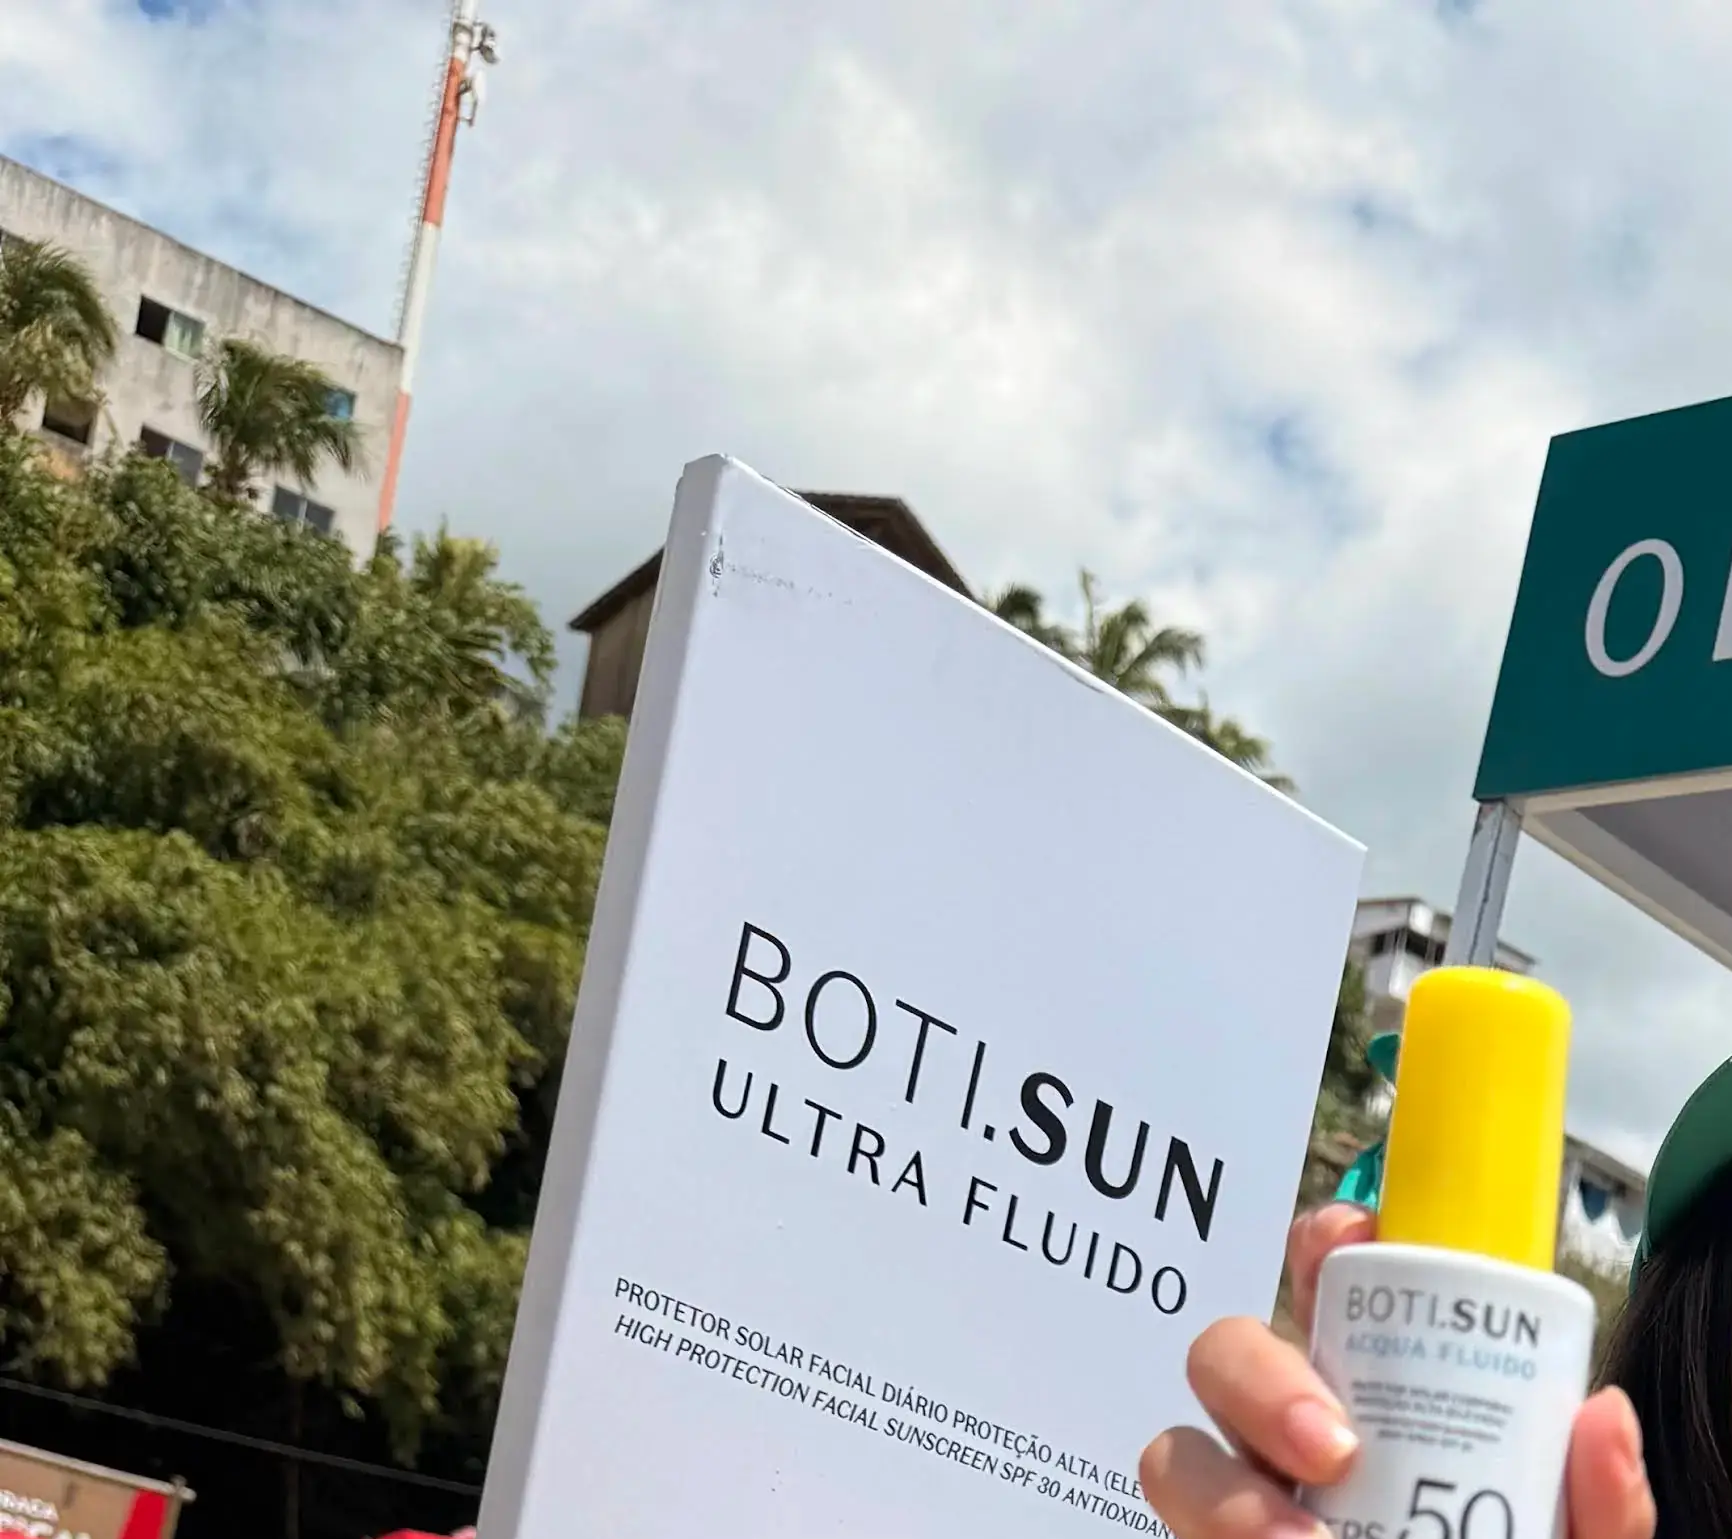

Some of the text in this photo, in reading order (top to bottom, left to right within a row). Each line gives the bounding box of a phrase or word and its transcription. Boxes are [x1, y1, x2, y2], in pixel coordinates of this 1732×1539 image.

[725, 921, 1224, 1242] BOTI.SUN
[711, 1058, 1188, 1315] ULTRA FLUIDO
[614, 1277, 731, 1341] PROTETOR
[734, 1325, 804, 1368] SOLAR
[808, 1353, 876, 1397] FACIAL
[881, 1381, 948, 1423] DIÁRIO
[952, 1409, 1052, 1463] PROTEÇÃO
[1055, 1451, 1099, 1483] ALTA
[614, 1314, 673, 1352] HIGH
[675, 1337, 811, 1404] PROTECTION
[811, 1390, 878, 1432] FACIAL
[883, 1417, 999, 1476] SUNSCREEN
[999, 1461, 1037, 1488] SPF
[1037, 1476, 1060, 1498] 30
[1346, 1283, 1541, 1350] BOTI.SUN
